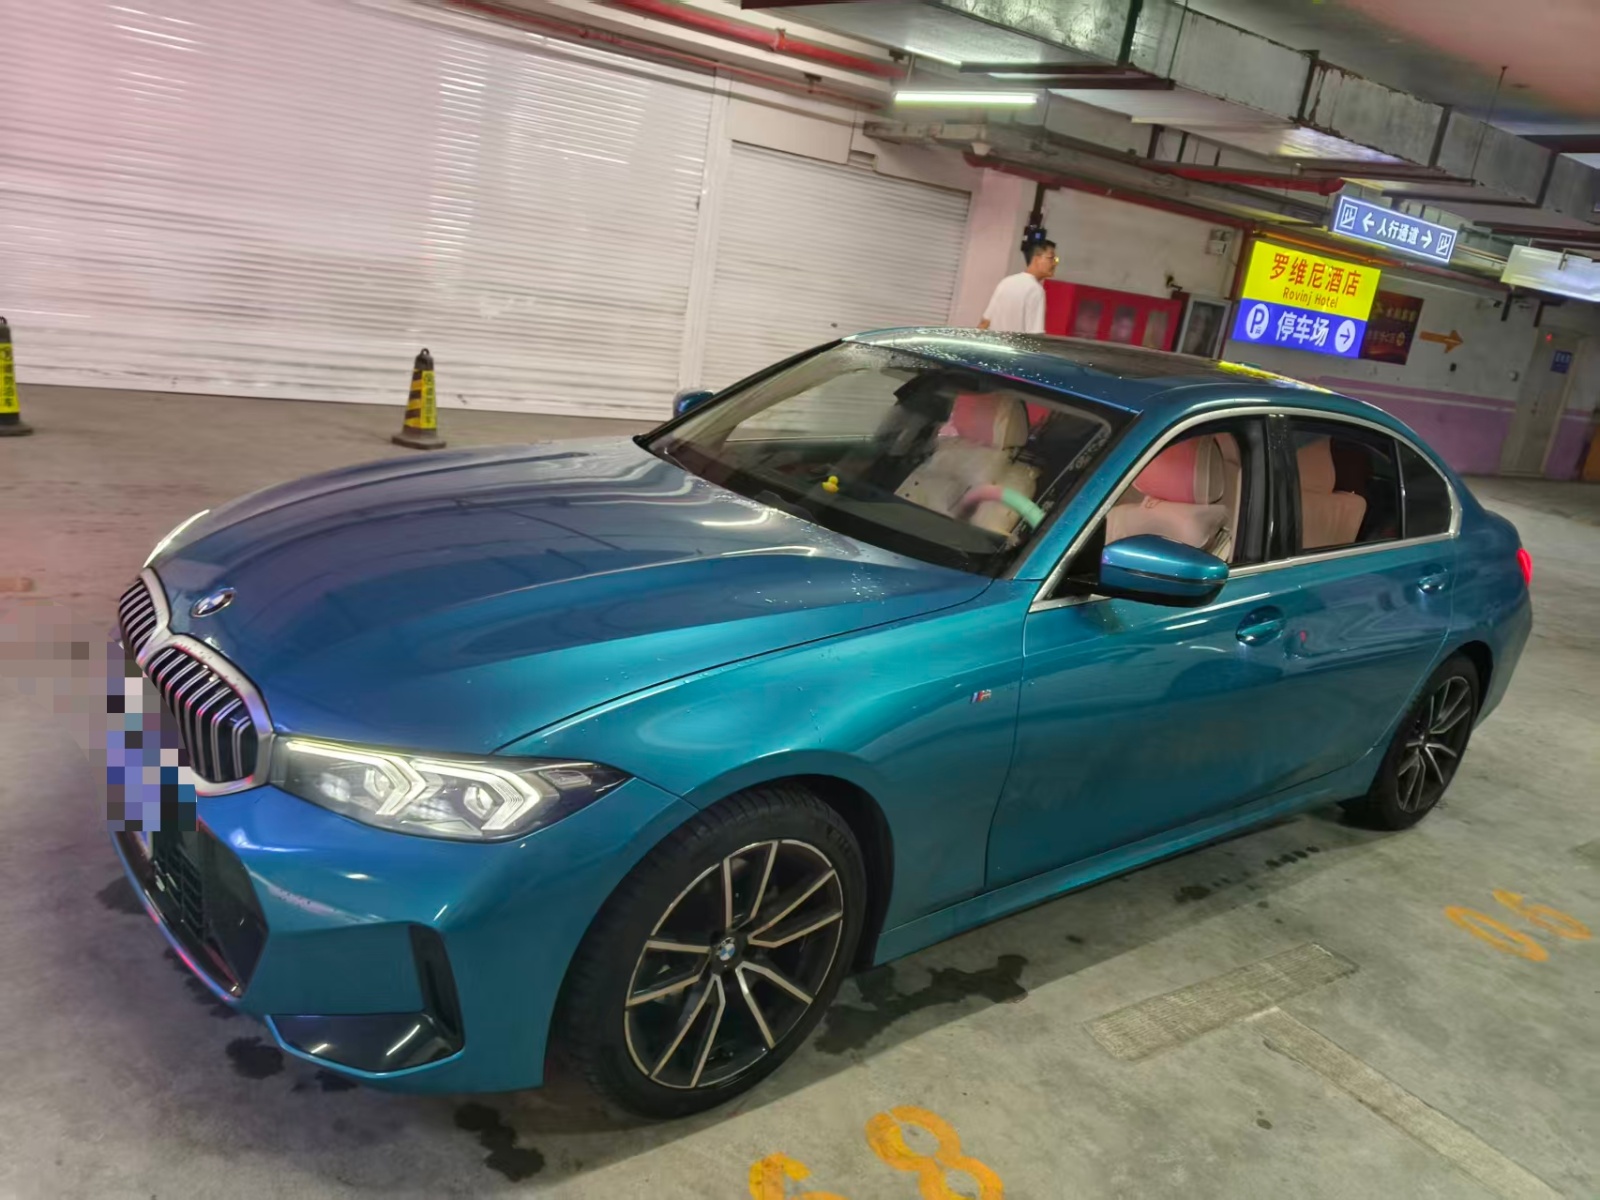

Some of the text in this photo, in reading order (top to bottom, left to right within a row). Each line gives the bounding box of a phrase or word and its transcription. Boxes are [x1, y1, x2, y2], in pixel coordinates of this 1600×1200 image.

[1376, 218, 1420, 245] 人行通道
[1269, 252, 1362, 297] 罗维尼酒店
[1282, 287, 1339, 308] Rovinj Hotel
[1250, 308, 1266, 334] P
[1275, 311, 1330, 347] 停车场
